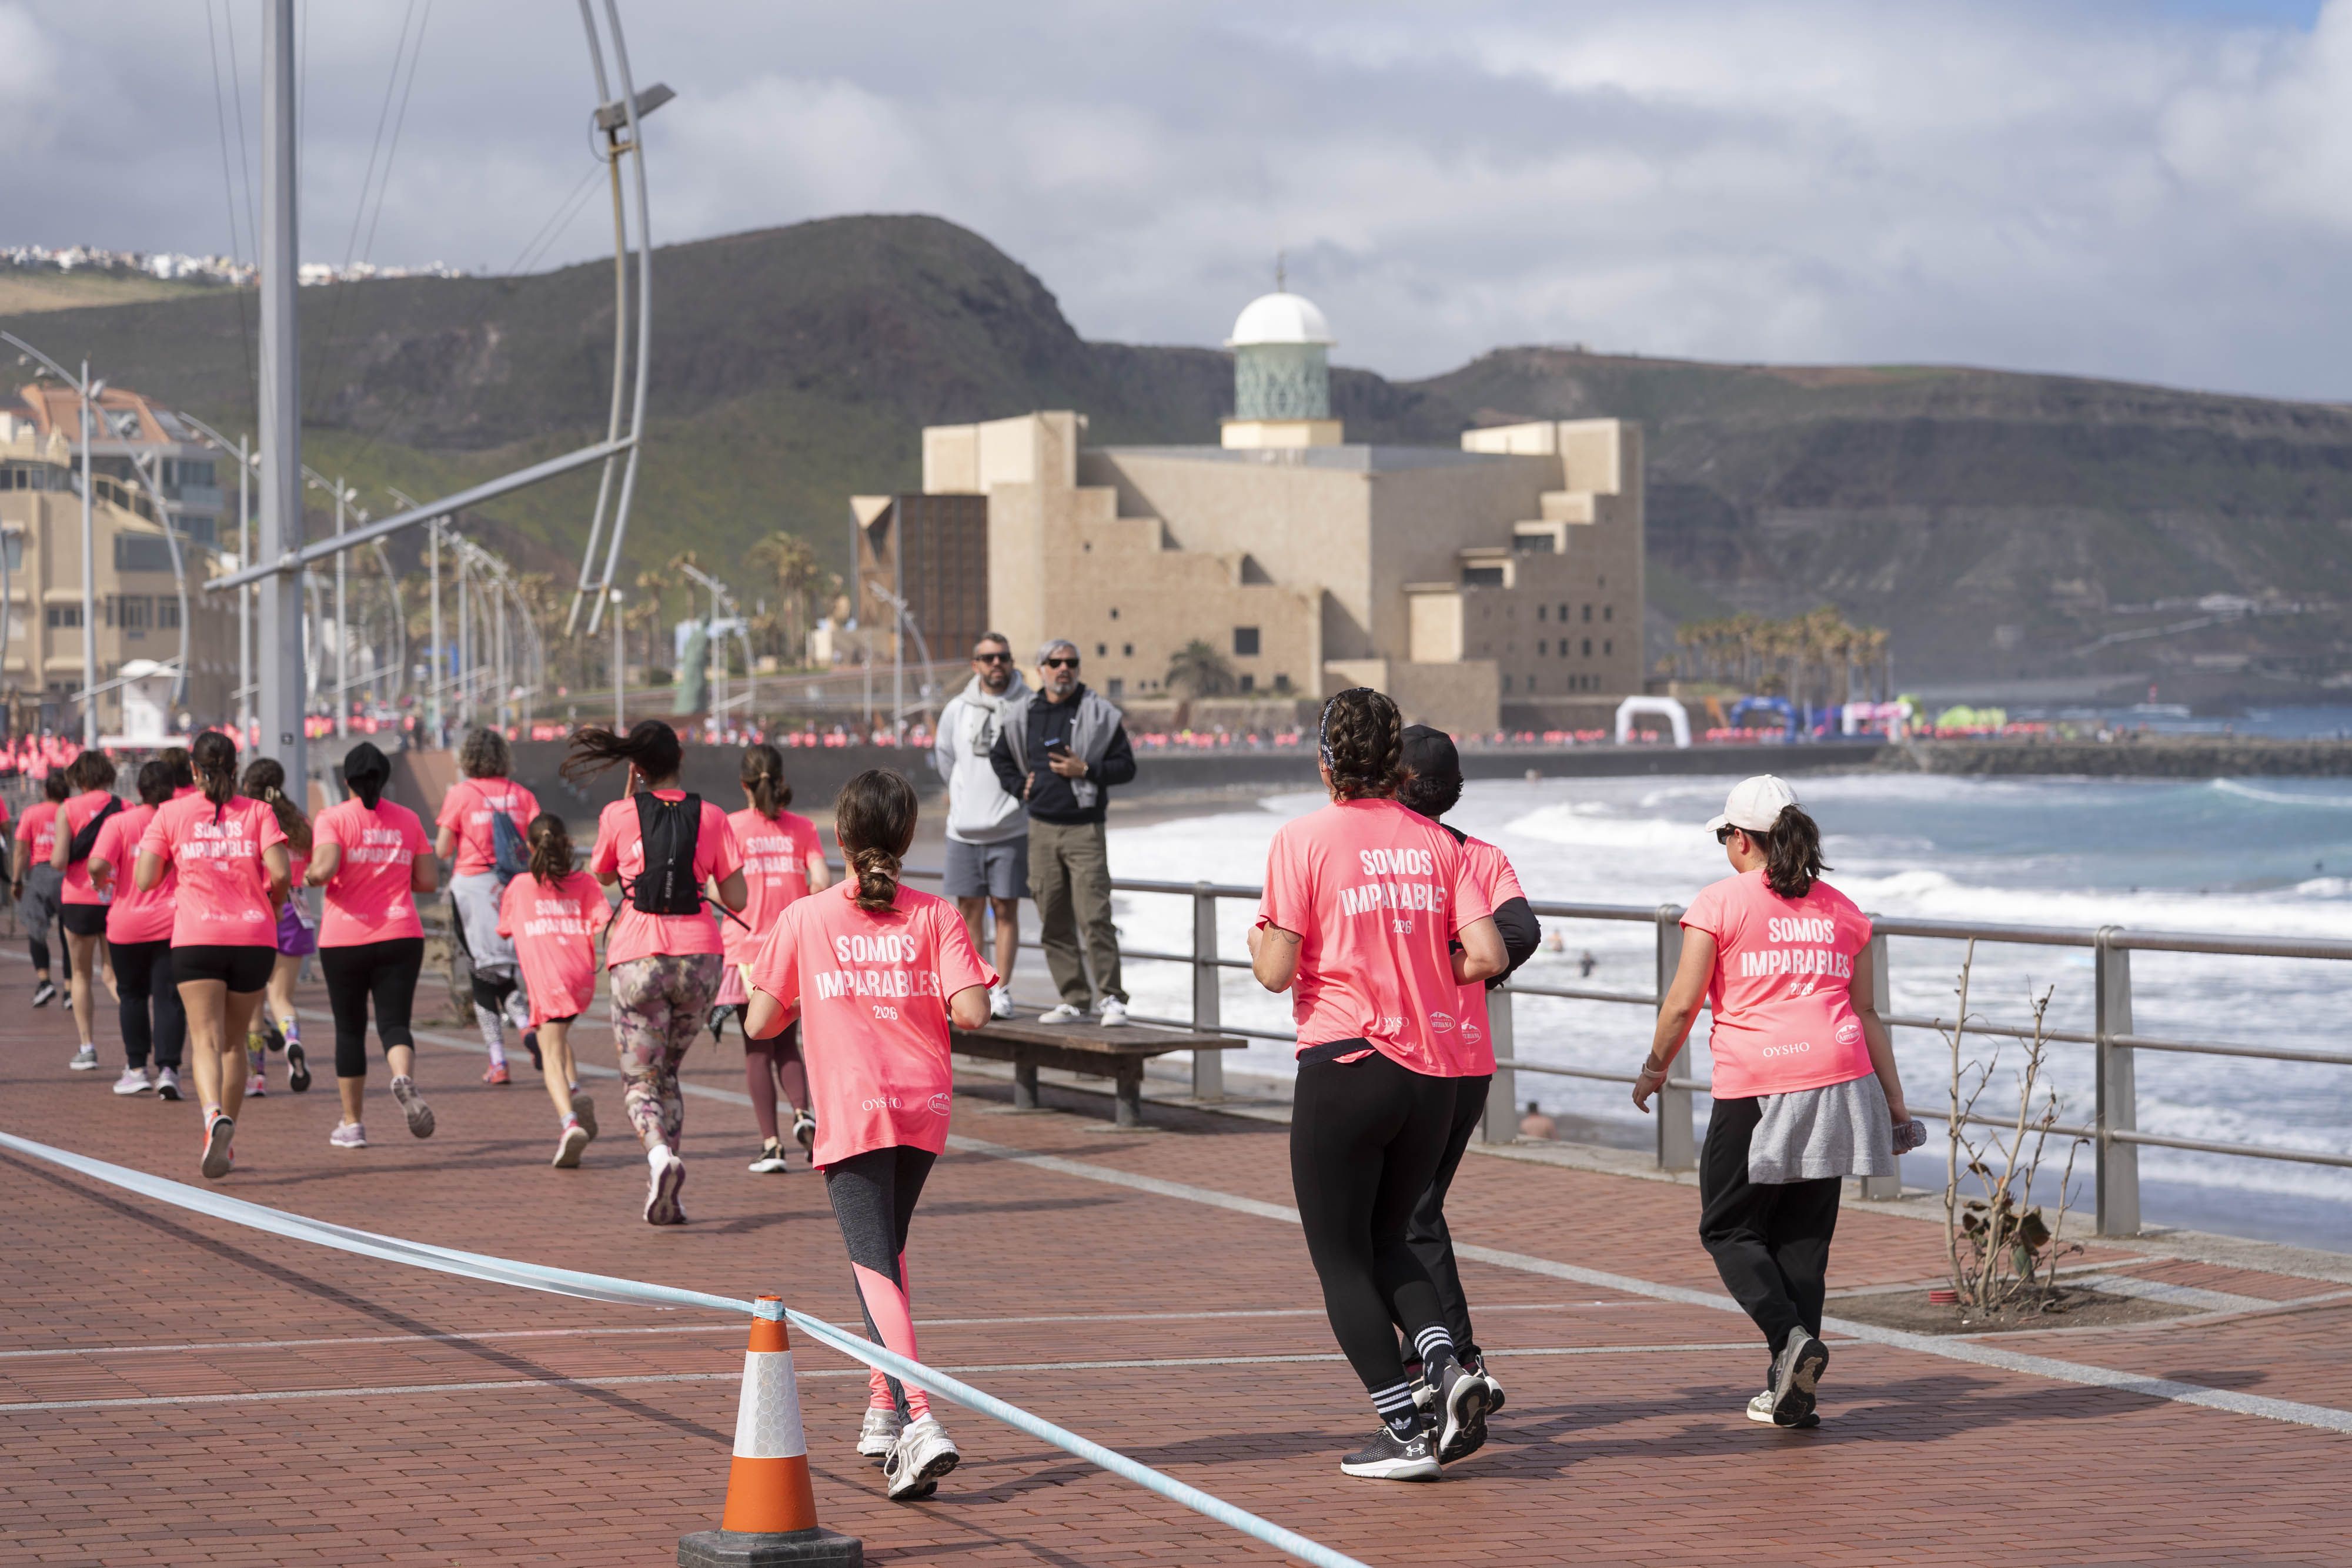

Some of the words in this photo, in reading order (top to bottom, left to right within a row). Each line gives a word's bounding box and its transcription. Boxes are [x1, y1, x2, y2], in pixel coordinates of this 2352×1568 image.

[194, 821, 243, 839] SOMOS
[363, 830, 403, 846] SOMOS
[746, 836, 793, 854] SOMOS
[1359, 848, 1434, 875] SOMOS
[534, 899, 582, 916] SOMOS
[1768, 917, 1835, 944] SOMOS
[836, 934, 917, 962] SOMOS
[1740, 948, 1850, 979] IMPARABLES
[814, 969, 940, 1000] IMPARABLES
[1790, 982, 1815, 996] 2026
[1380, 1017, 1410, 1028] OYSO
[1763, 1042, 1810, 1058] OYSHO
